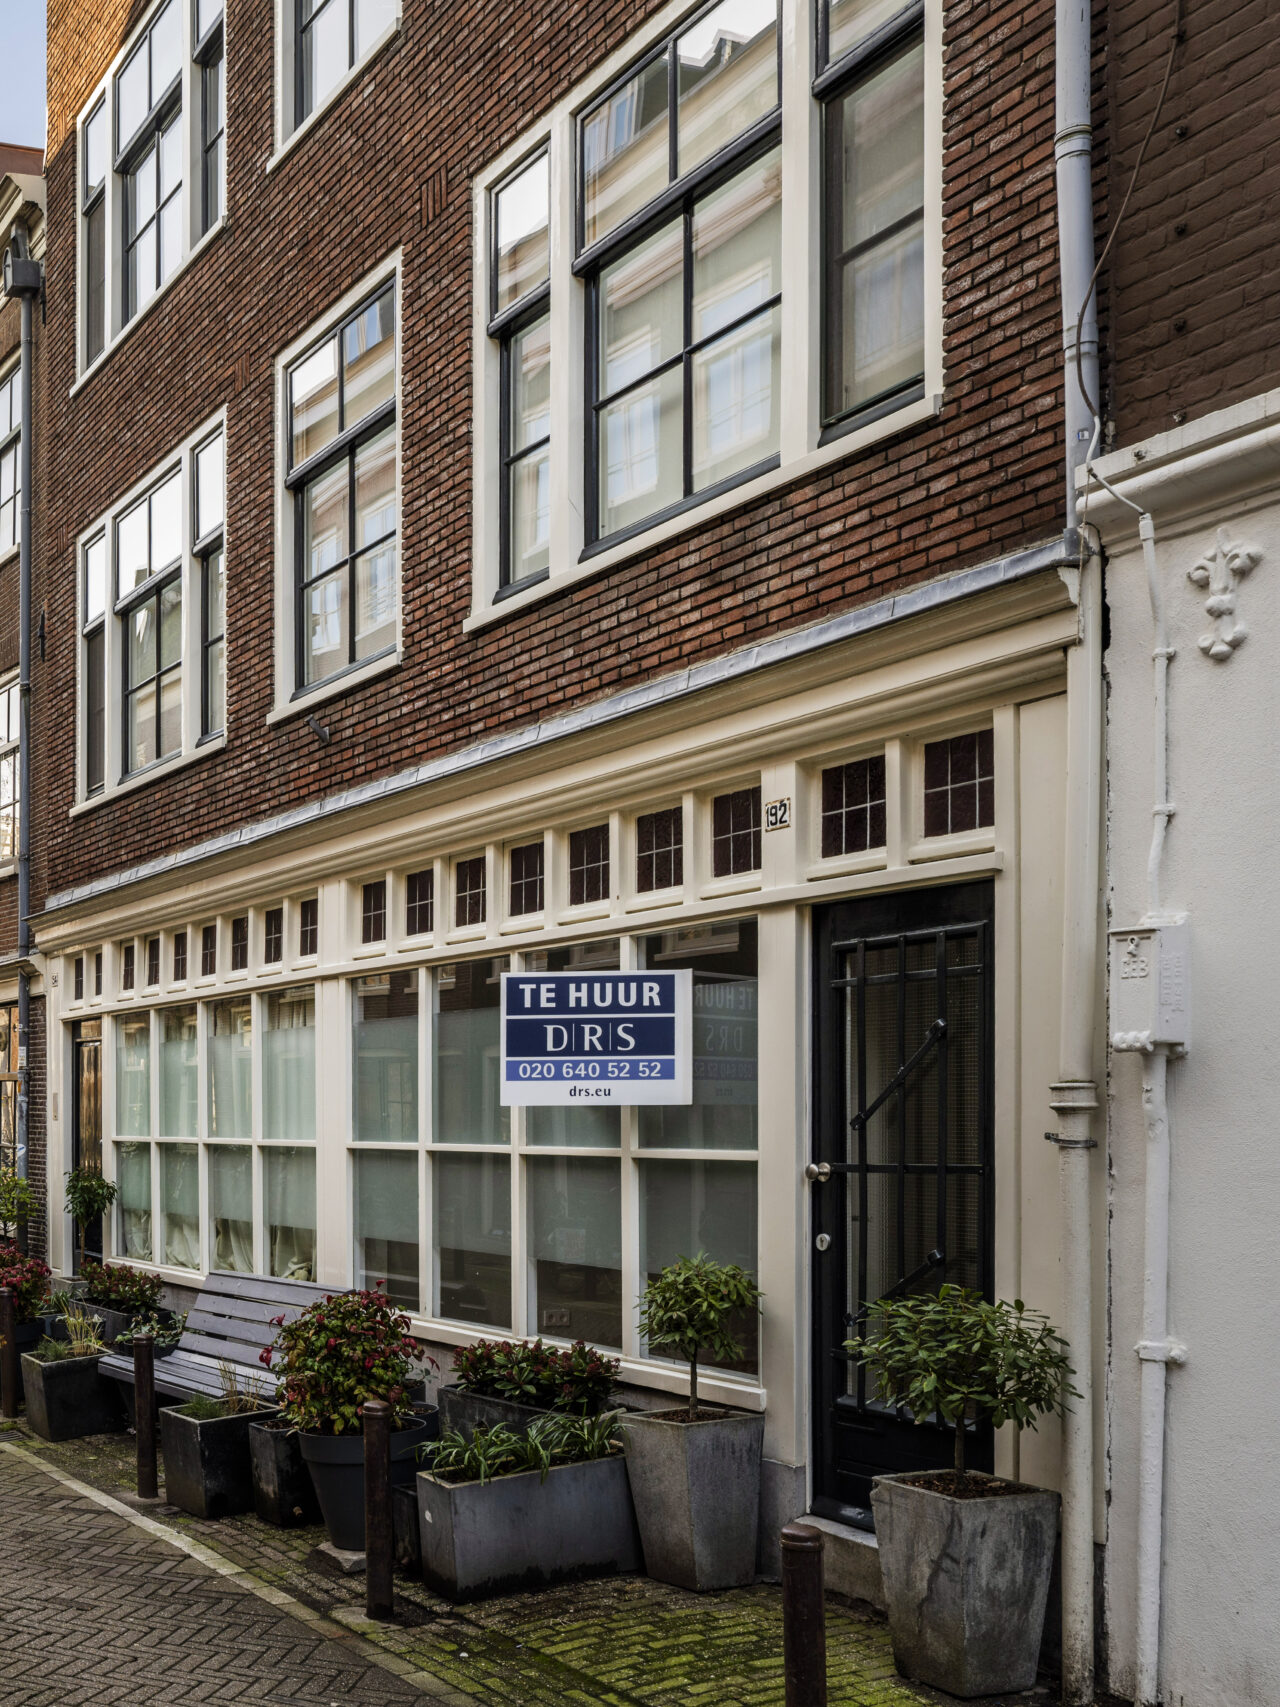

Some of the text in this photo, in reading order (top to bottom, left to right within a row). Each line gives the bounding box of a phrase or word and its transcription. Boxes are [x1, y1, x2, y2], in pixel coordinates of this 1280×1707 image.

[766, 803, 787, 827] 192
[519, 982, 661, 1008] TE HUUR
[519, 1061, 661, 1078] 020 640 52 52
[569, 1086, 611, 1097] drs.eu
